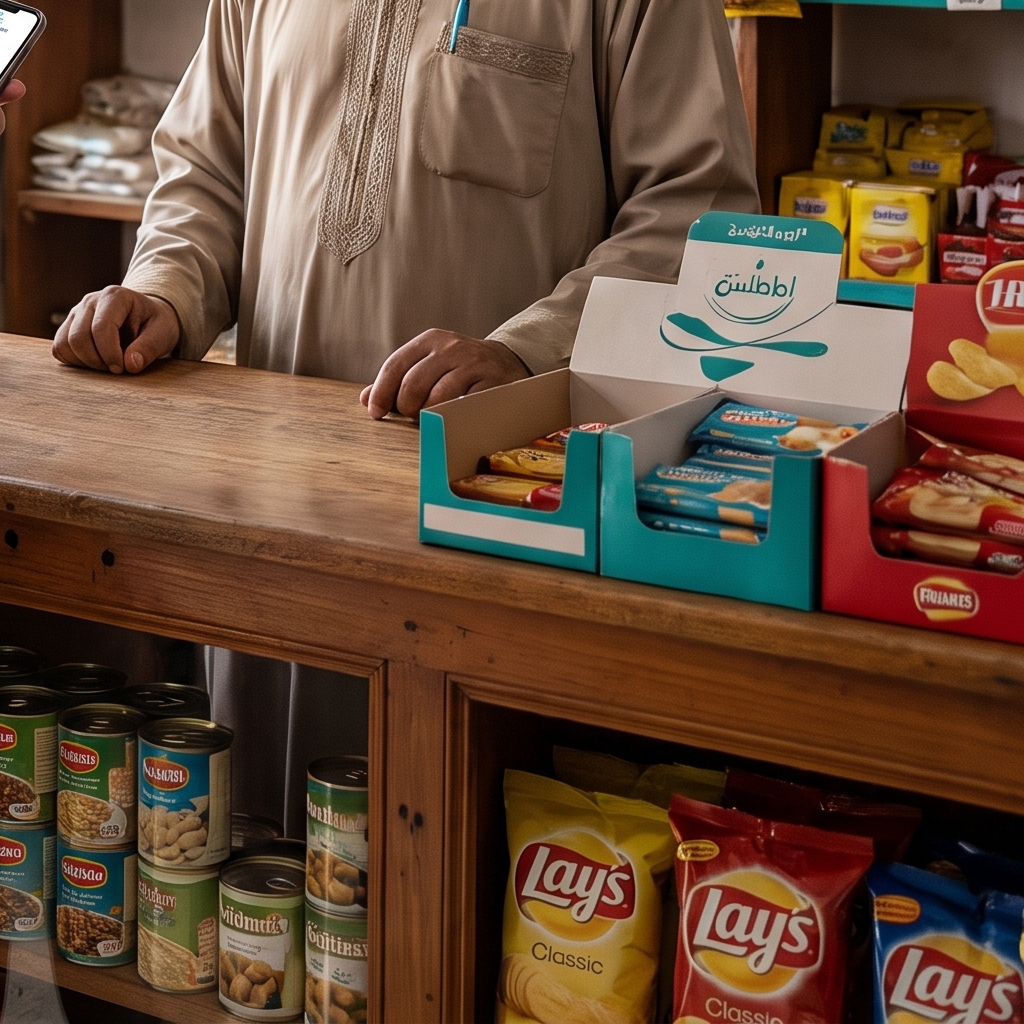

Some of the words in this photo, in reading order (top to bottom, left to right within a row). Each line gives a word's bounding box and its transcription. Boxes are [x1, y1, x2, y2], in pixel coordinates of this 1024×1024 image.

[521, 845, 632, 923] Lay's
[531, 942, 605, 975] Classic
[692, 887, 815, 974] Lay's
[889, 947, 1021, 1024] Lay's
